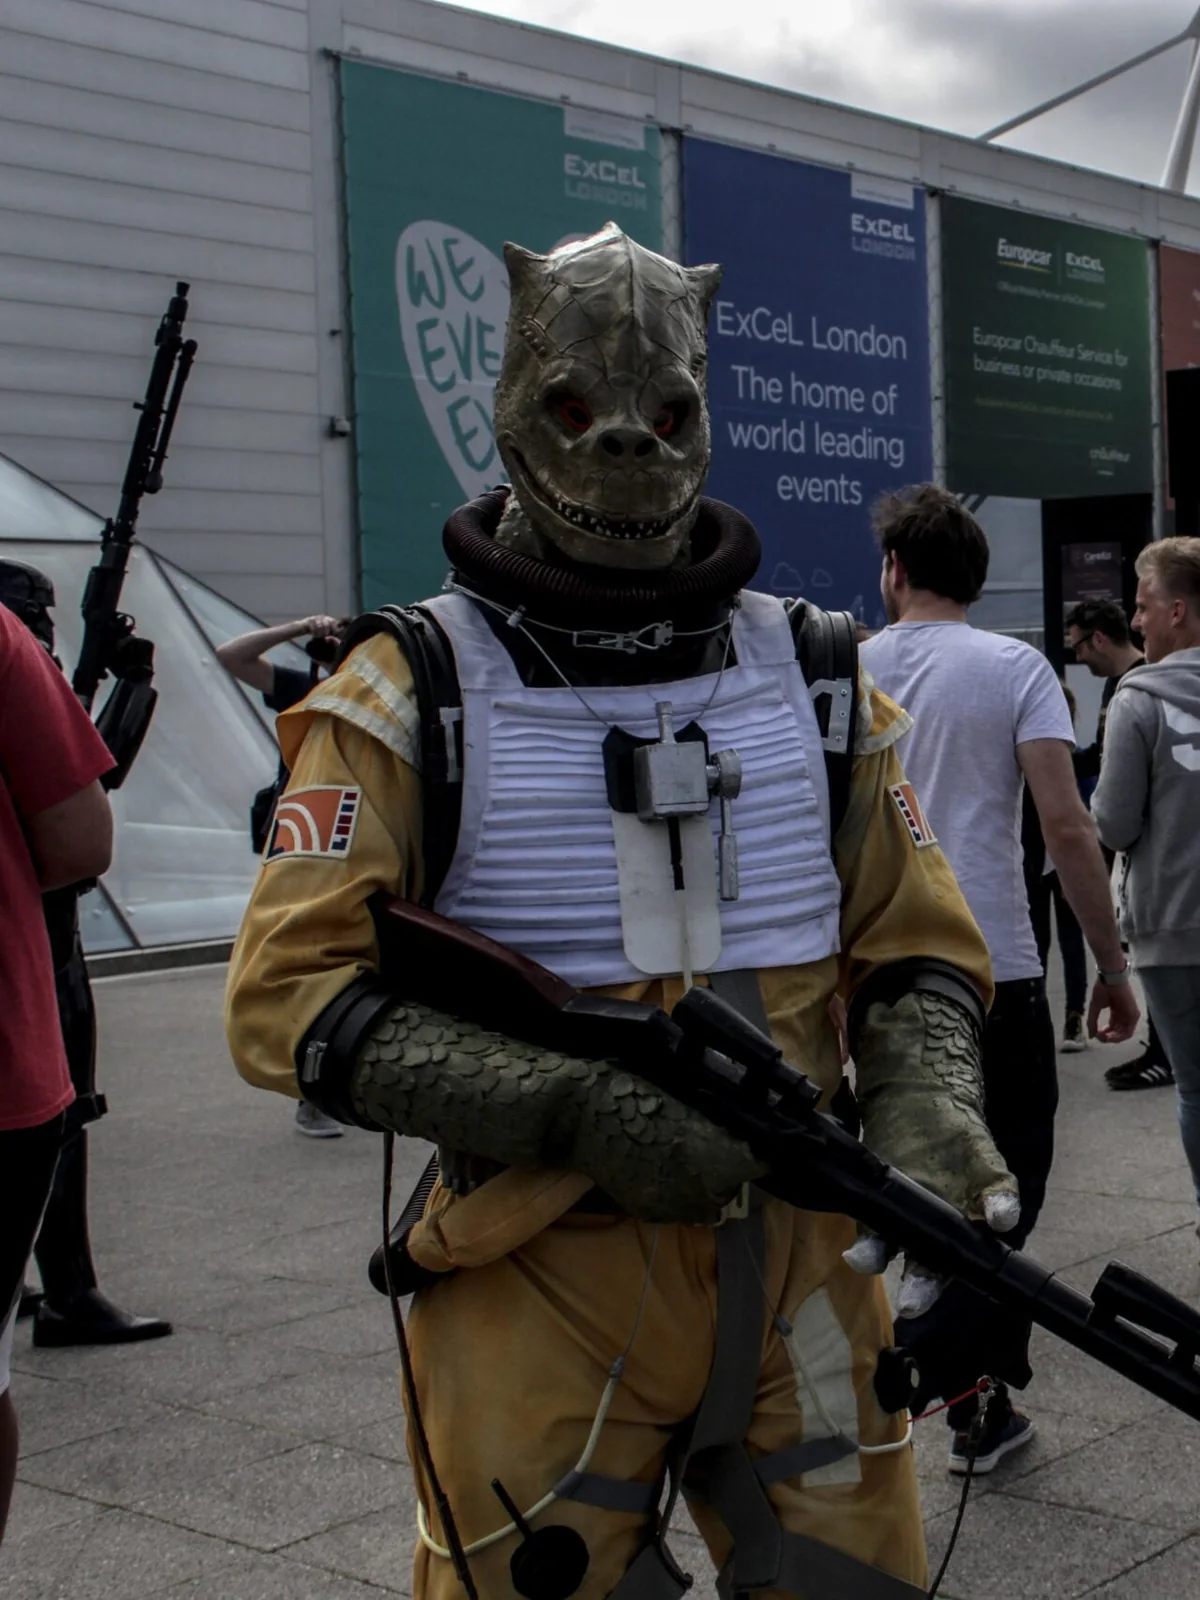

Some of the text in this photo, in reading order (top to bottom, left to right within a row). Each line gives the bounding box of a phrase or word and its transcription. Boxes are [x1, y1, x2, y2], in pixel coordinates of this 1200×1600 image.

[406, 238, 485, 310] WE
[997, 237, 1053, 268] Europcar
[716, 300, 908, 360] ExCeL London
[973, 326, 1021, 352] Europcar
[1024, 335, 1075, 358] Chauffeur
[1076, 343, 1113, 365] Service
[730, 364, 898, 415] The home of
[973, 353, 1020, 377] business
[1022, 365, 1034, 378] or
[1036, 364, 1072, 384] private
[728, 418, 905, 468] world leading
[776, 473, 863, 506] events
